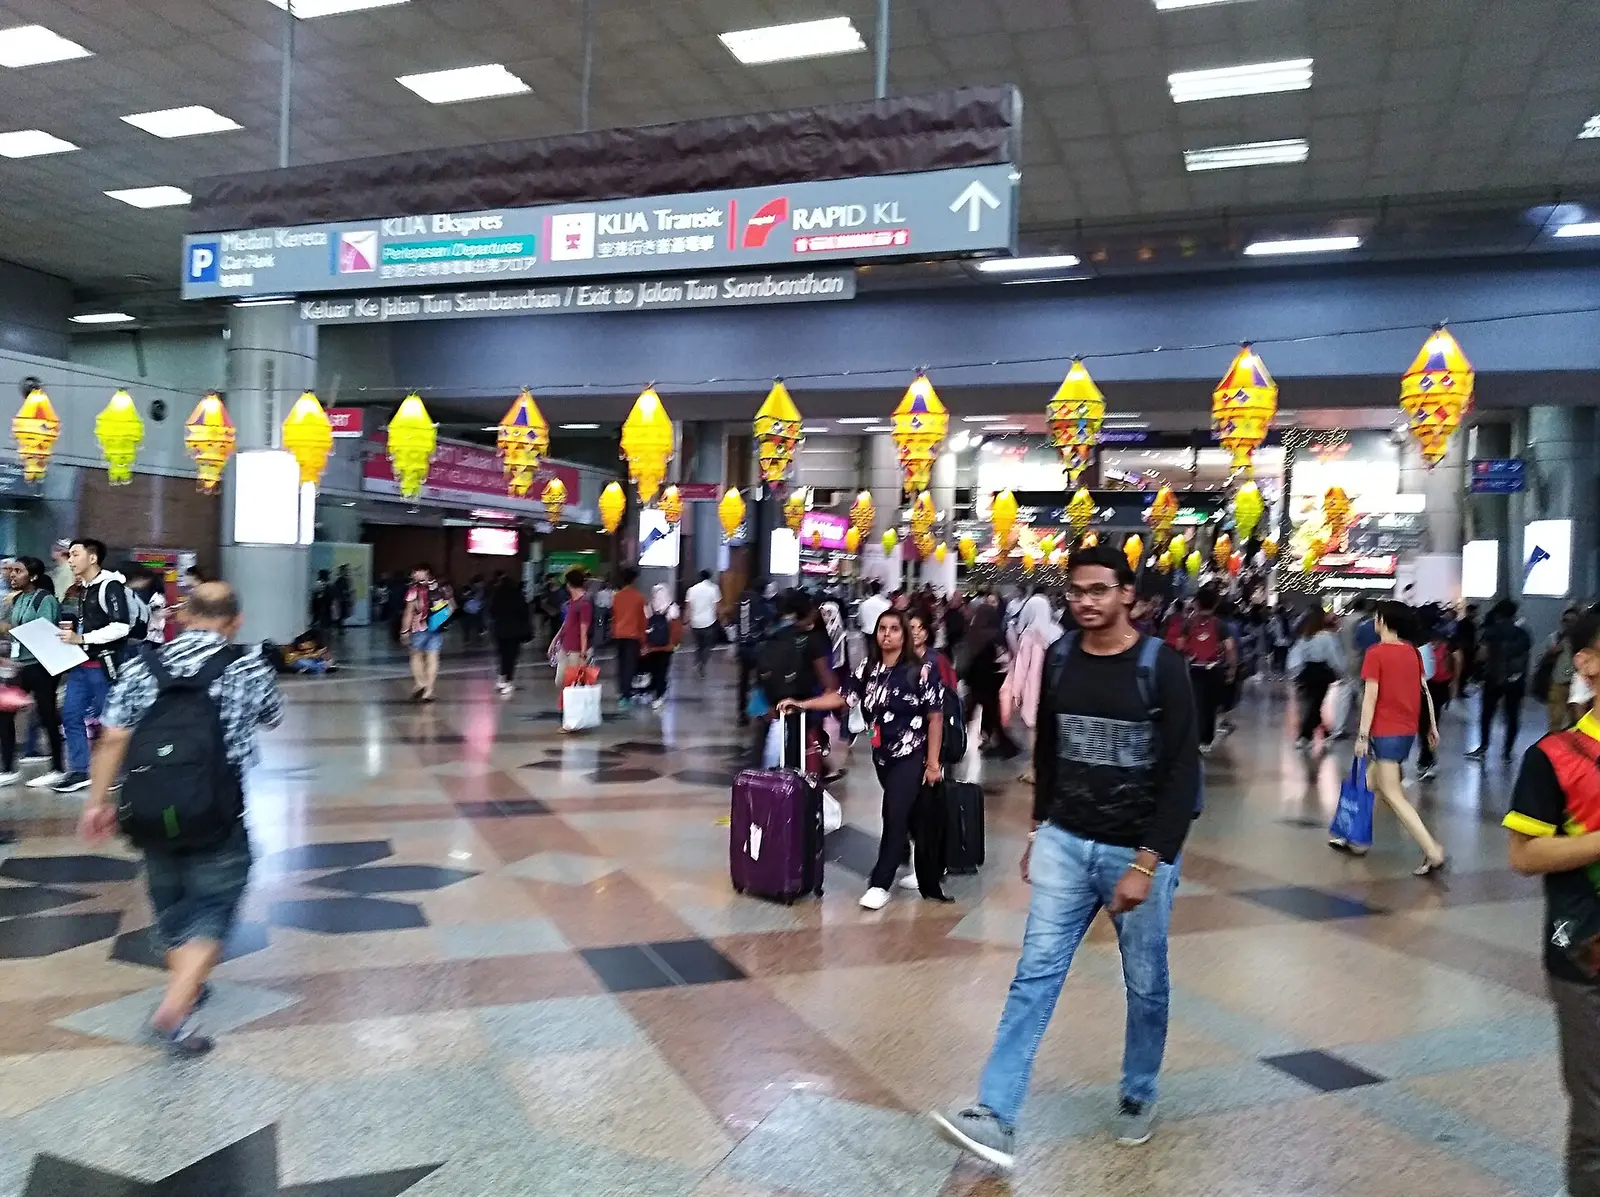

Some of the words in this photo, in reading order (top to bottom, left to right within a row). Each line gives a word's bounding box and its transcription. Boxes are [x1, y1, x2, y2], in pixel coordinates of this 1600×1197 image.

[380, 215, 428, 237] KLIA
[431, 213, 505, 237] Ekspres
[597, 211, 649, 236] KLIA
[652, 206, 725, 232] Transit
[792, 204, 868, 231] RAPID
[873, 200, 908, 225] KL
[191, 248, 214, 278] P
[219, 254, 245, 271] Car
[300, 299, 353, 320] Keluar
[354, 298, 379, 318] Ke
[380, 296, 420, 321] Jalan
[419, 294, 451, 314] Tun
[576, 285, 613, 307] Exit
[614, 286, 635, 305] to
[635, 281, 684, 308] Jalan
[684, 279, 718, 301] Tun
[721, 272, 846, 300] Sambanthan
